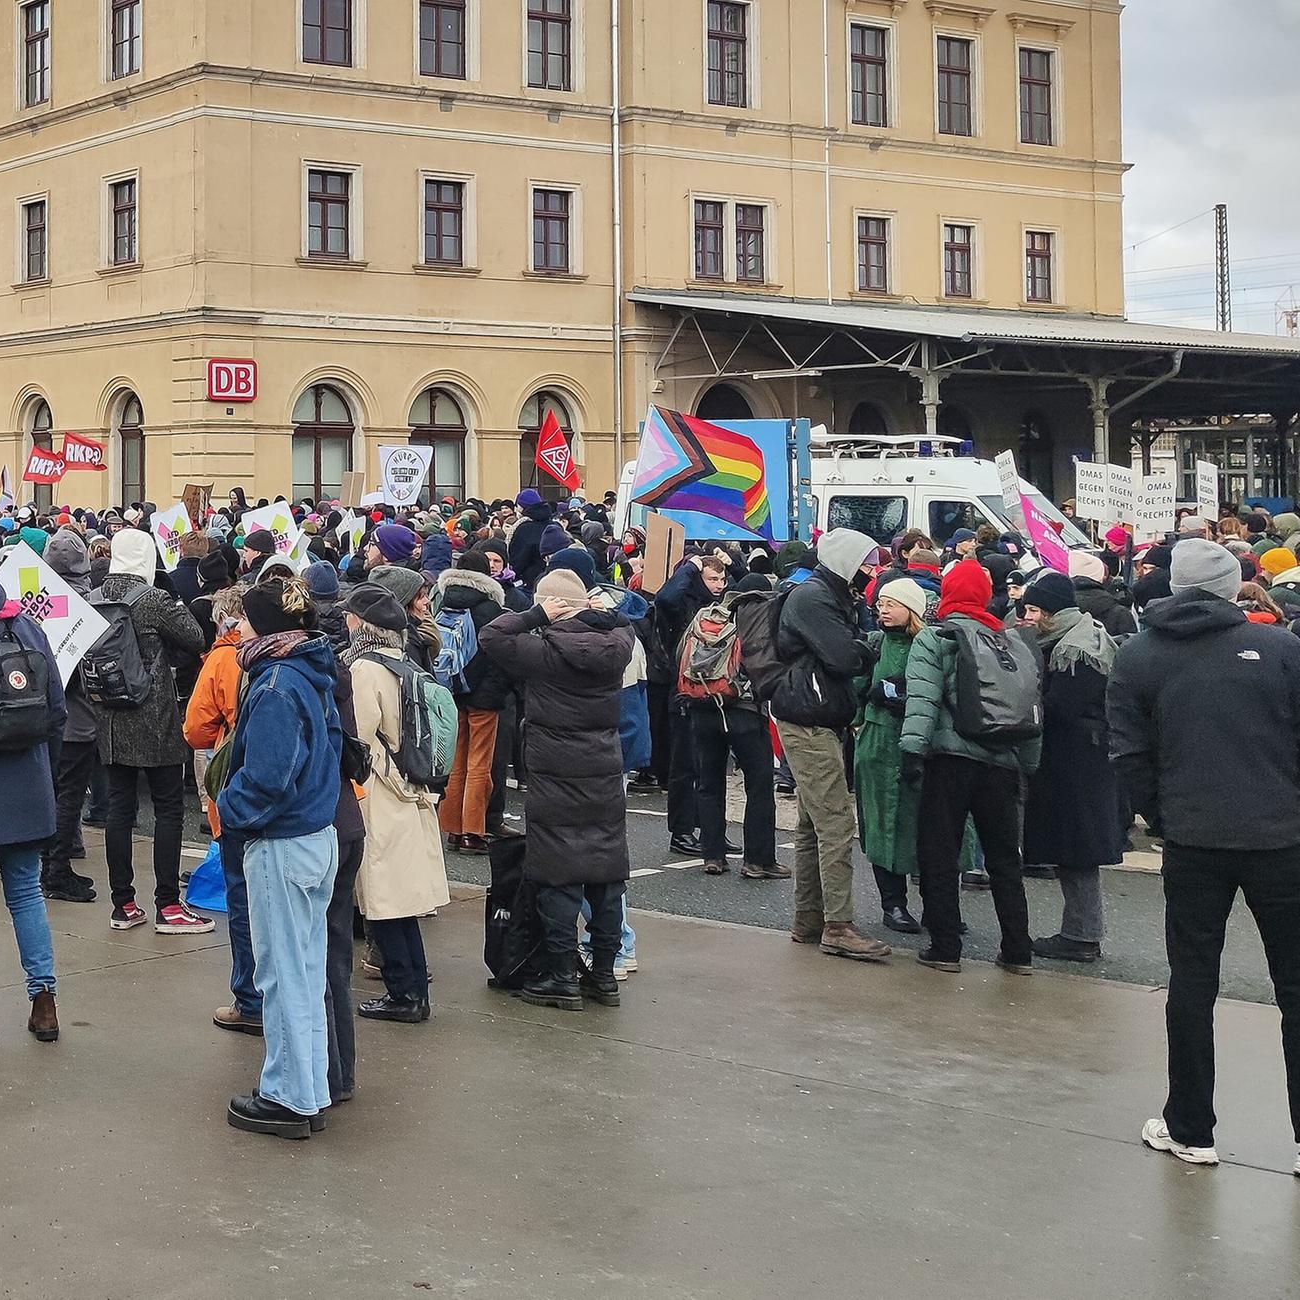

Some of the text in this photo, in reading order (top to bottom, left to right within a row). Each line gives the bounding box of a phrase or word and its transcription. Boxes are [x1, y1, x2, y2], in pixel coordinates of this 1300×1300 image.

[216, 367, 251, 393] DB
[1080, 469, 1103, 479] OMAS
[1111, 472, 1132, 484] OMAS
[1079, 483, 1104, 493] GEGEN
[1109, 485, 1133, 497] GEGEN
[1147, 482, 1172, 491] OMAS
[1078, 496, 1105, 507] RECHTS
[1108, 498, 1134, 511] RECHTS
[1143, 510, 1174, 519] RECHTS
[25, 586, 50, 616] RBOT
[35, 599, 54, 624] TZT
